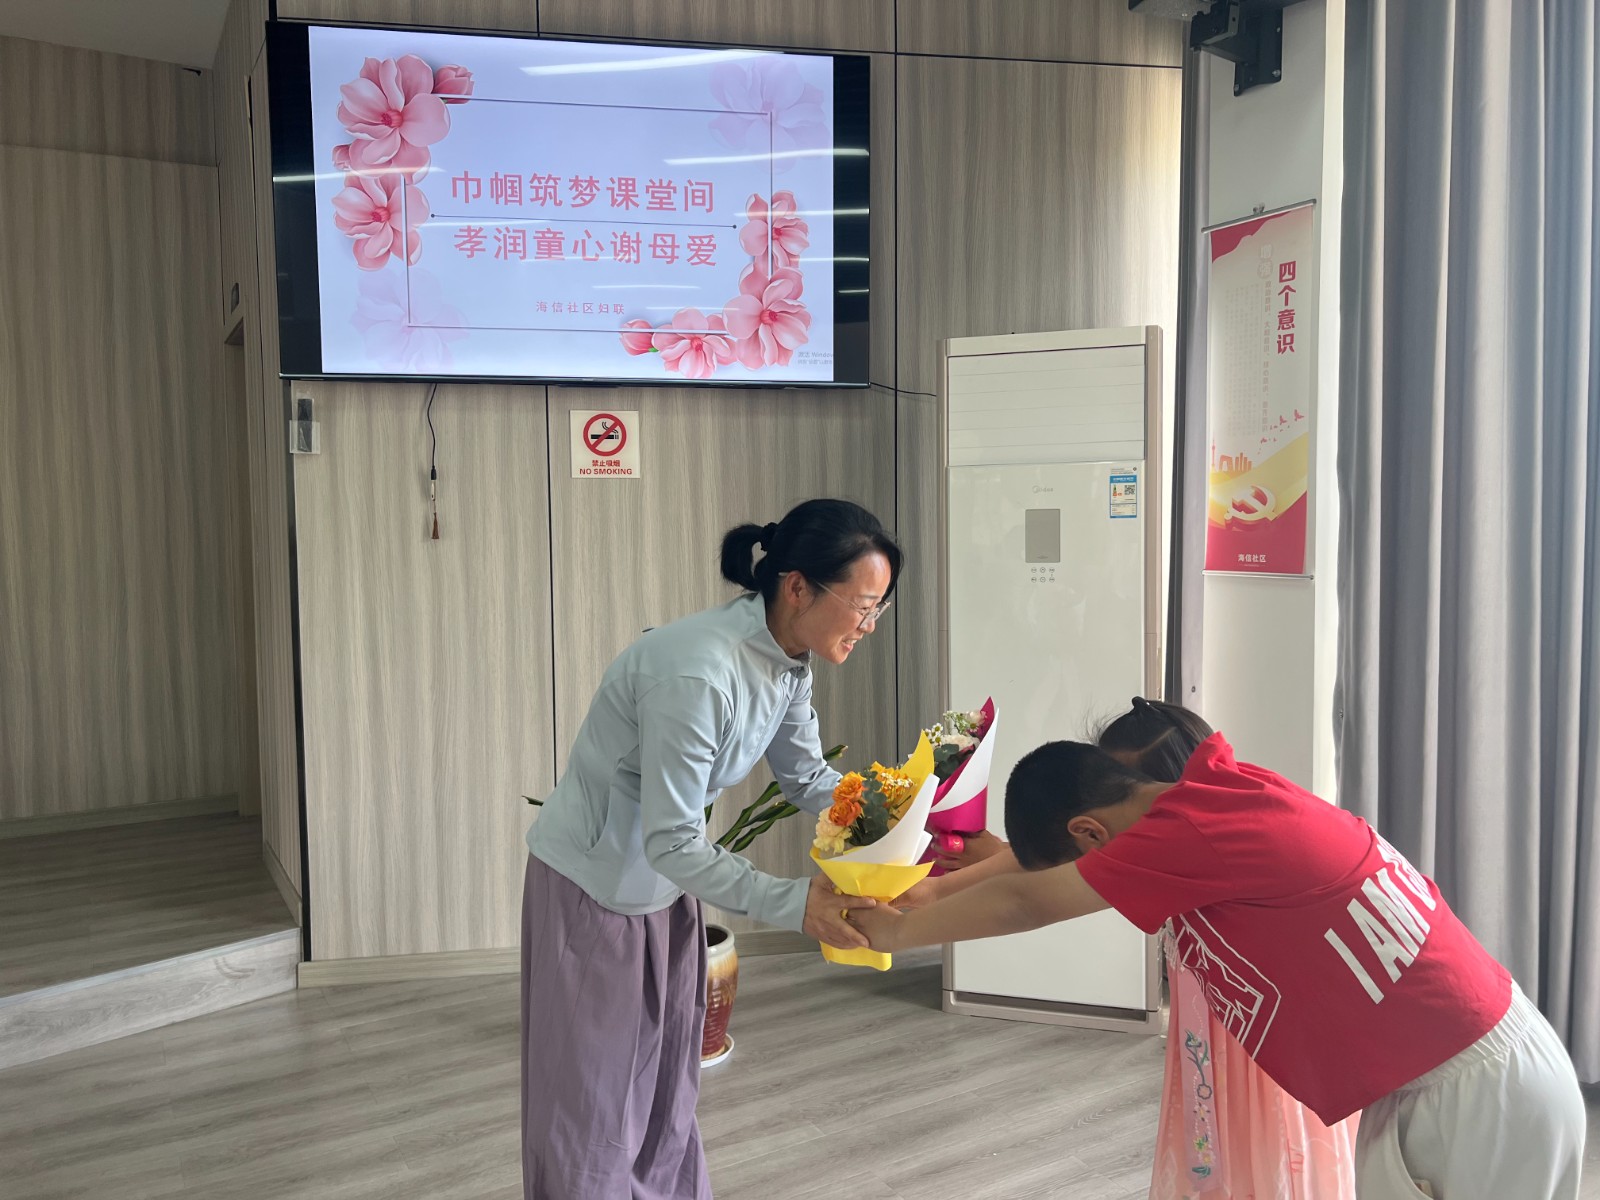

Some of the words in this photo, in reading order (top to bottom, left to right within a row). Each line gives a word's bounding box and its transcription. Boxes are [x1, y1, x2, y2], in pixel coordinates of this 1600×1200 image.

[451, 170, 714, 213] 巾帼筑梦课堂间
[454, 225, 717, 266] 孝润童心谢母爱
[536, 301, 625, 315] 海信社区妇联
[1277, 260, 1297, 355] 四个意识
[1347, 867, 1430, 984] AM
[1324, 928, 1384, 1004] I
